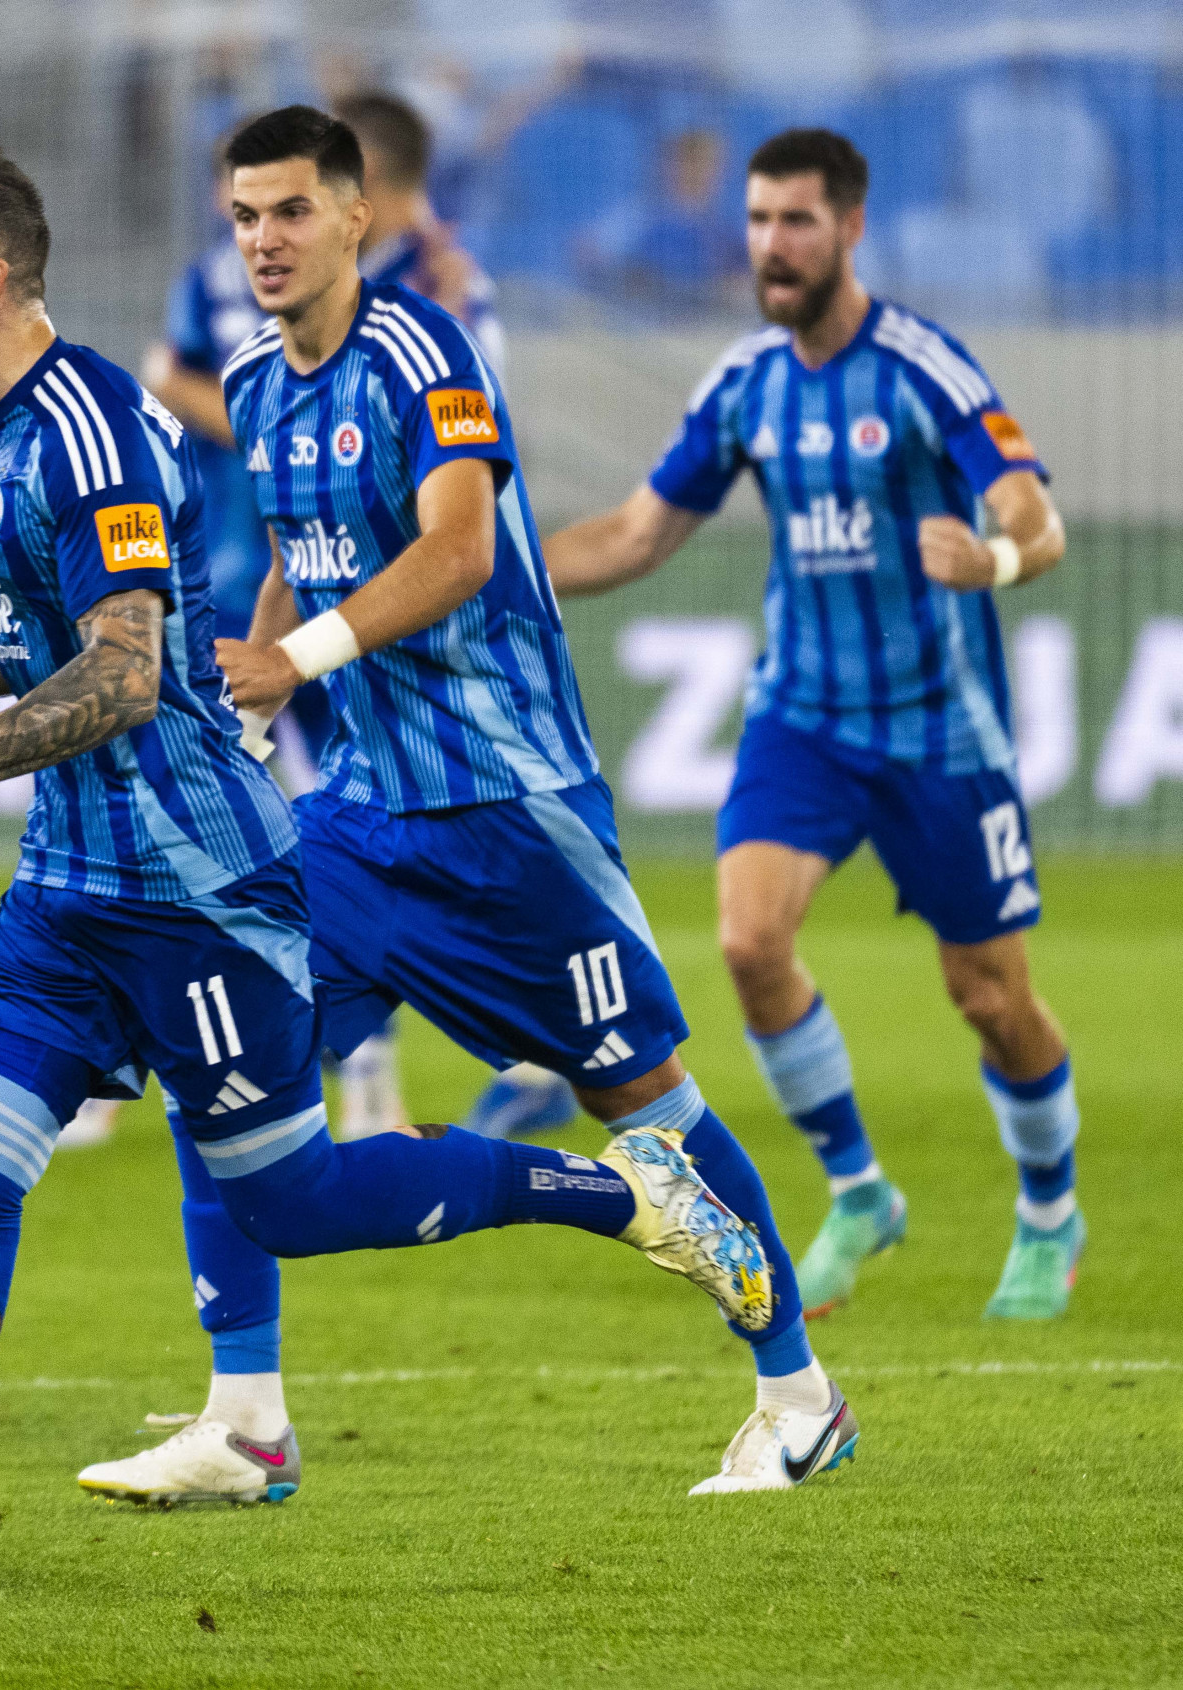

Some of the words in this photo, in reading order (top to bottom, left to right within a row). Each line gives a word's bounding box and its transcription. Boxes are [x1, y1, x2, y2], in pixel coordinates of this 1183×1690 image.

[438, 395, 486, 421] niké
[442, 419, 492, 438] LIGA
[106, 510, 159, 544] niké
[114, 539, 166, 562] LIGA
[287, 517, 361, 580] niké
[980, 801, 1031, 882] 12
[567, 940, 627, 1026] 10
[186, 975, 243, 1066] 11
